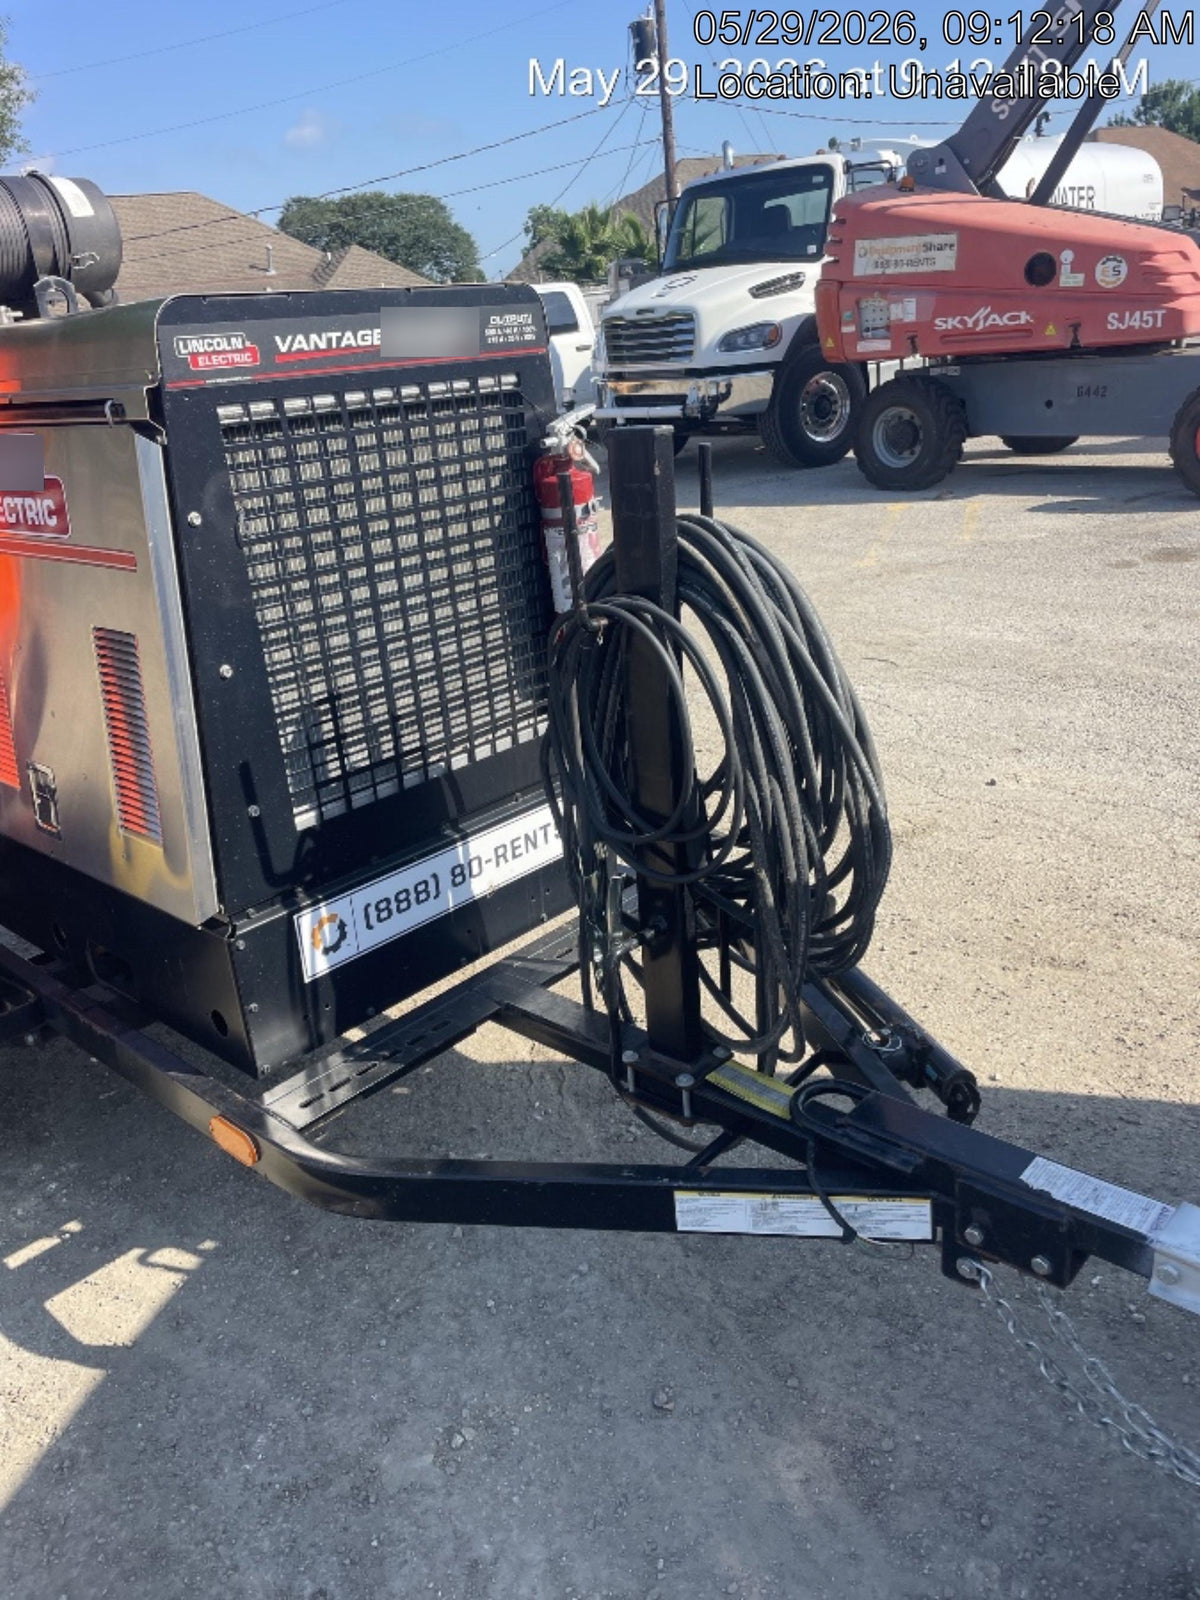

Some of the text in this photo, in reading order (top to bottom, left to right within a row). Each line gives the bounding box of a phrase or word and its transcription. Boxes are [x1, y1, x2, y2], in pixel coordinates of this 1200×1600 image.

[934, 306, 1167, 331] SKYJACK SJ45T
[178, 336, 243, 354] LINCOLN
[274, 328, 381, 354] VANTAGE
[198, 352, 254, 367] ELECTRIC
[363, 820, 561, 931] (888) 80-RENT
